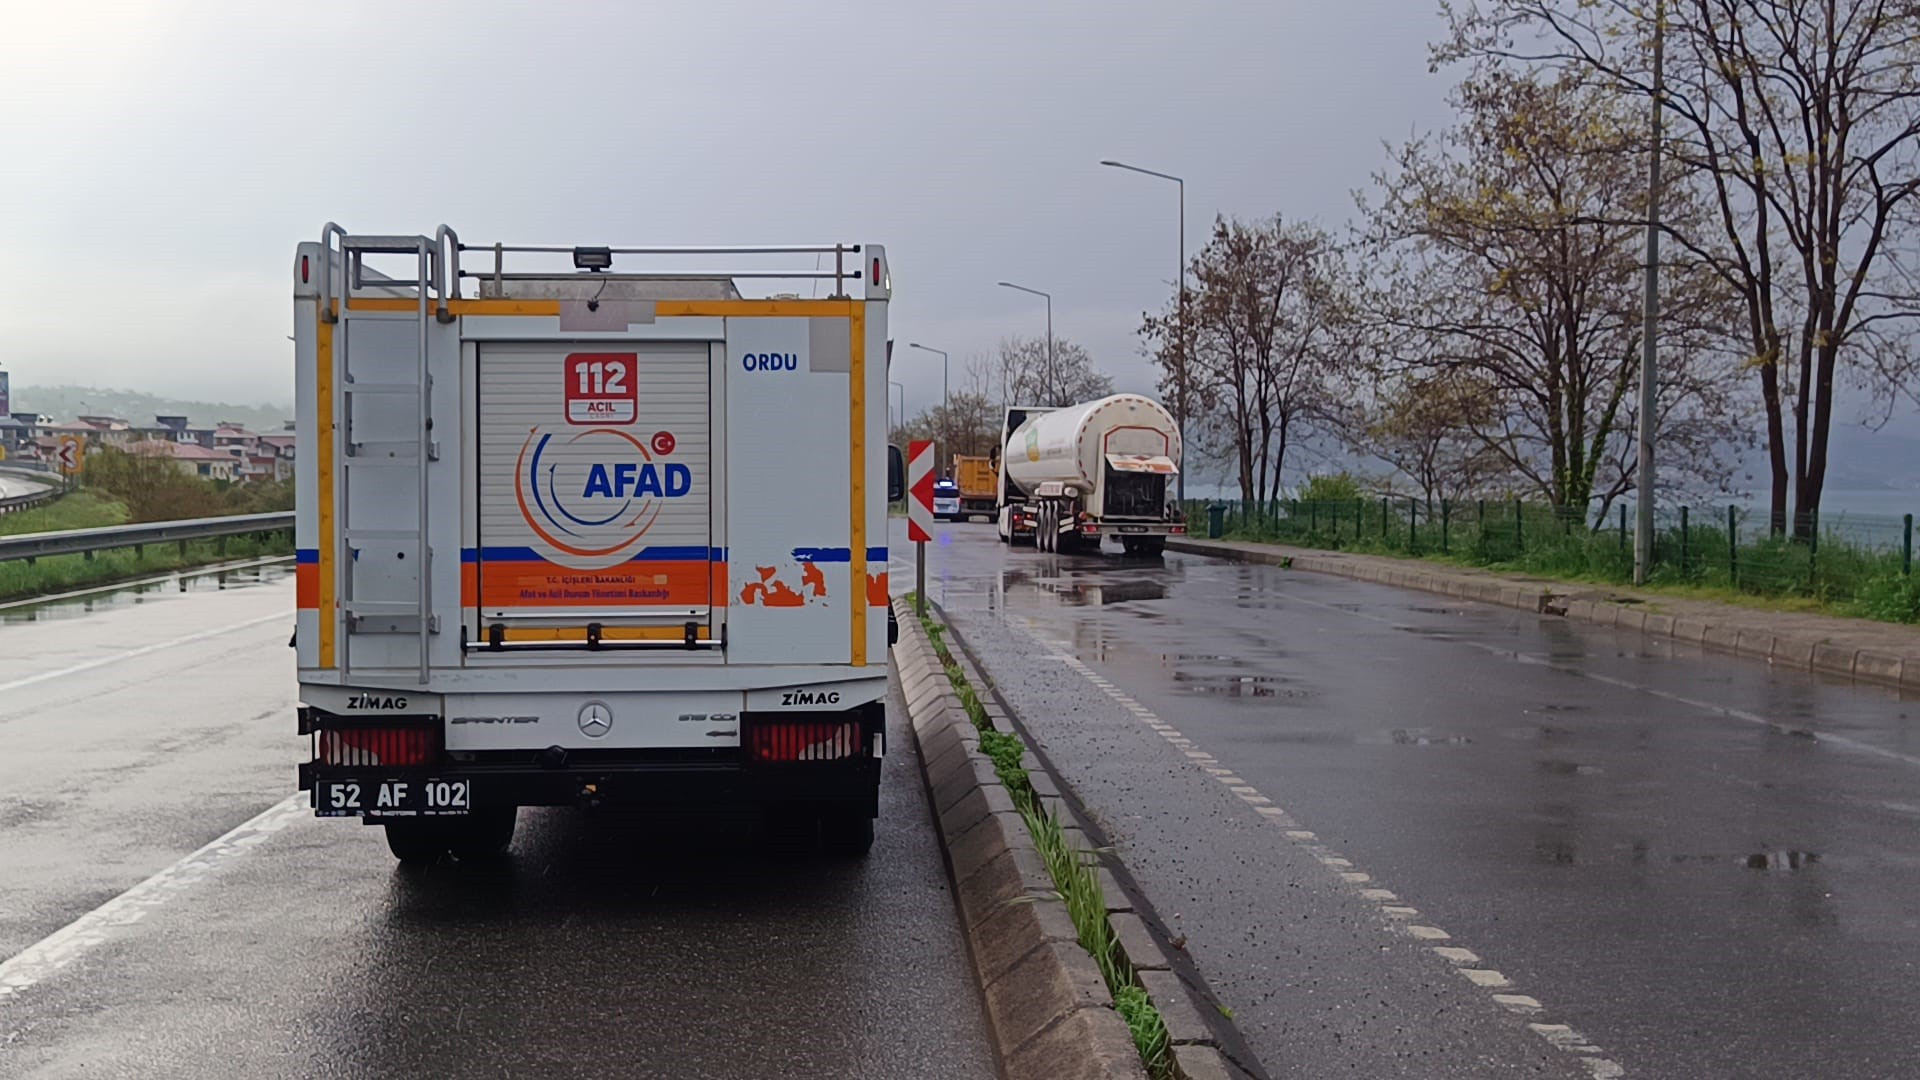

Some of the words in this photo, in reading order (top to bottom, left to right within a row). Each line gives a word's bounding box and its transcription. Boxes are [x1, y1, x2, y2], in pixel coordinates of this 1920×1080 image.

[743, 353, 797, 371] ORDU
[575, 361, 627, 394] 112
[583, 463, 692, 498] AFAD
[330, 783, 361, 808] 52
[377, 783, 408, 807] AF
[425, 782, 466, 807] 102
